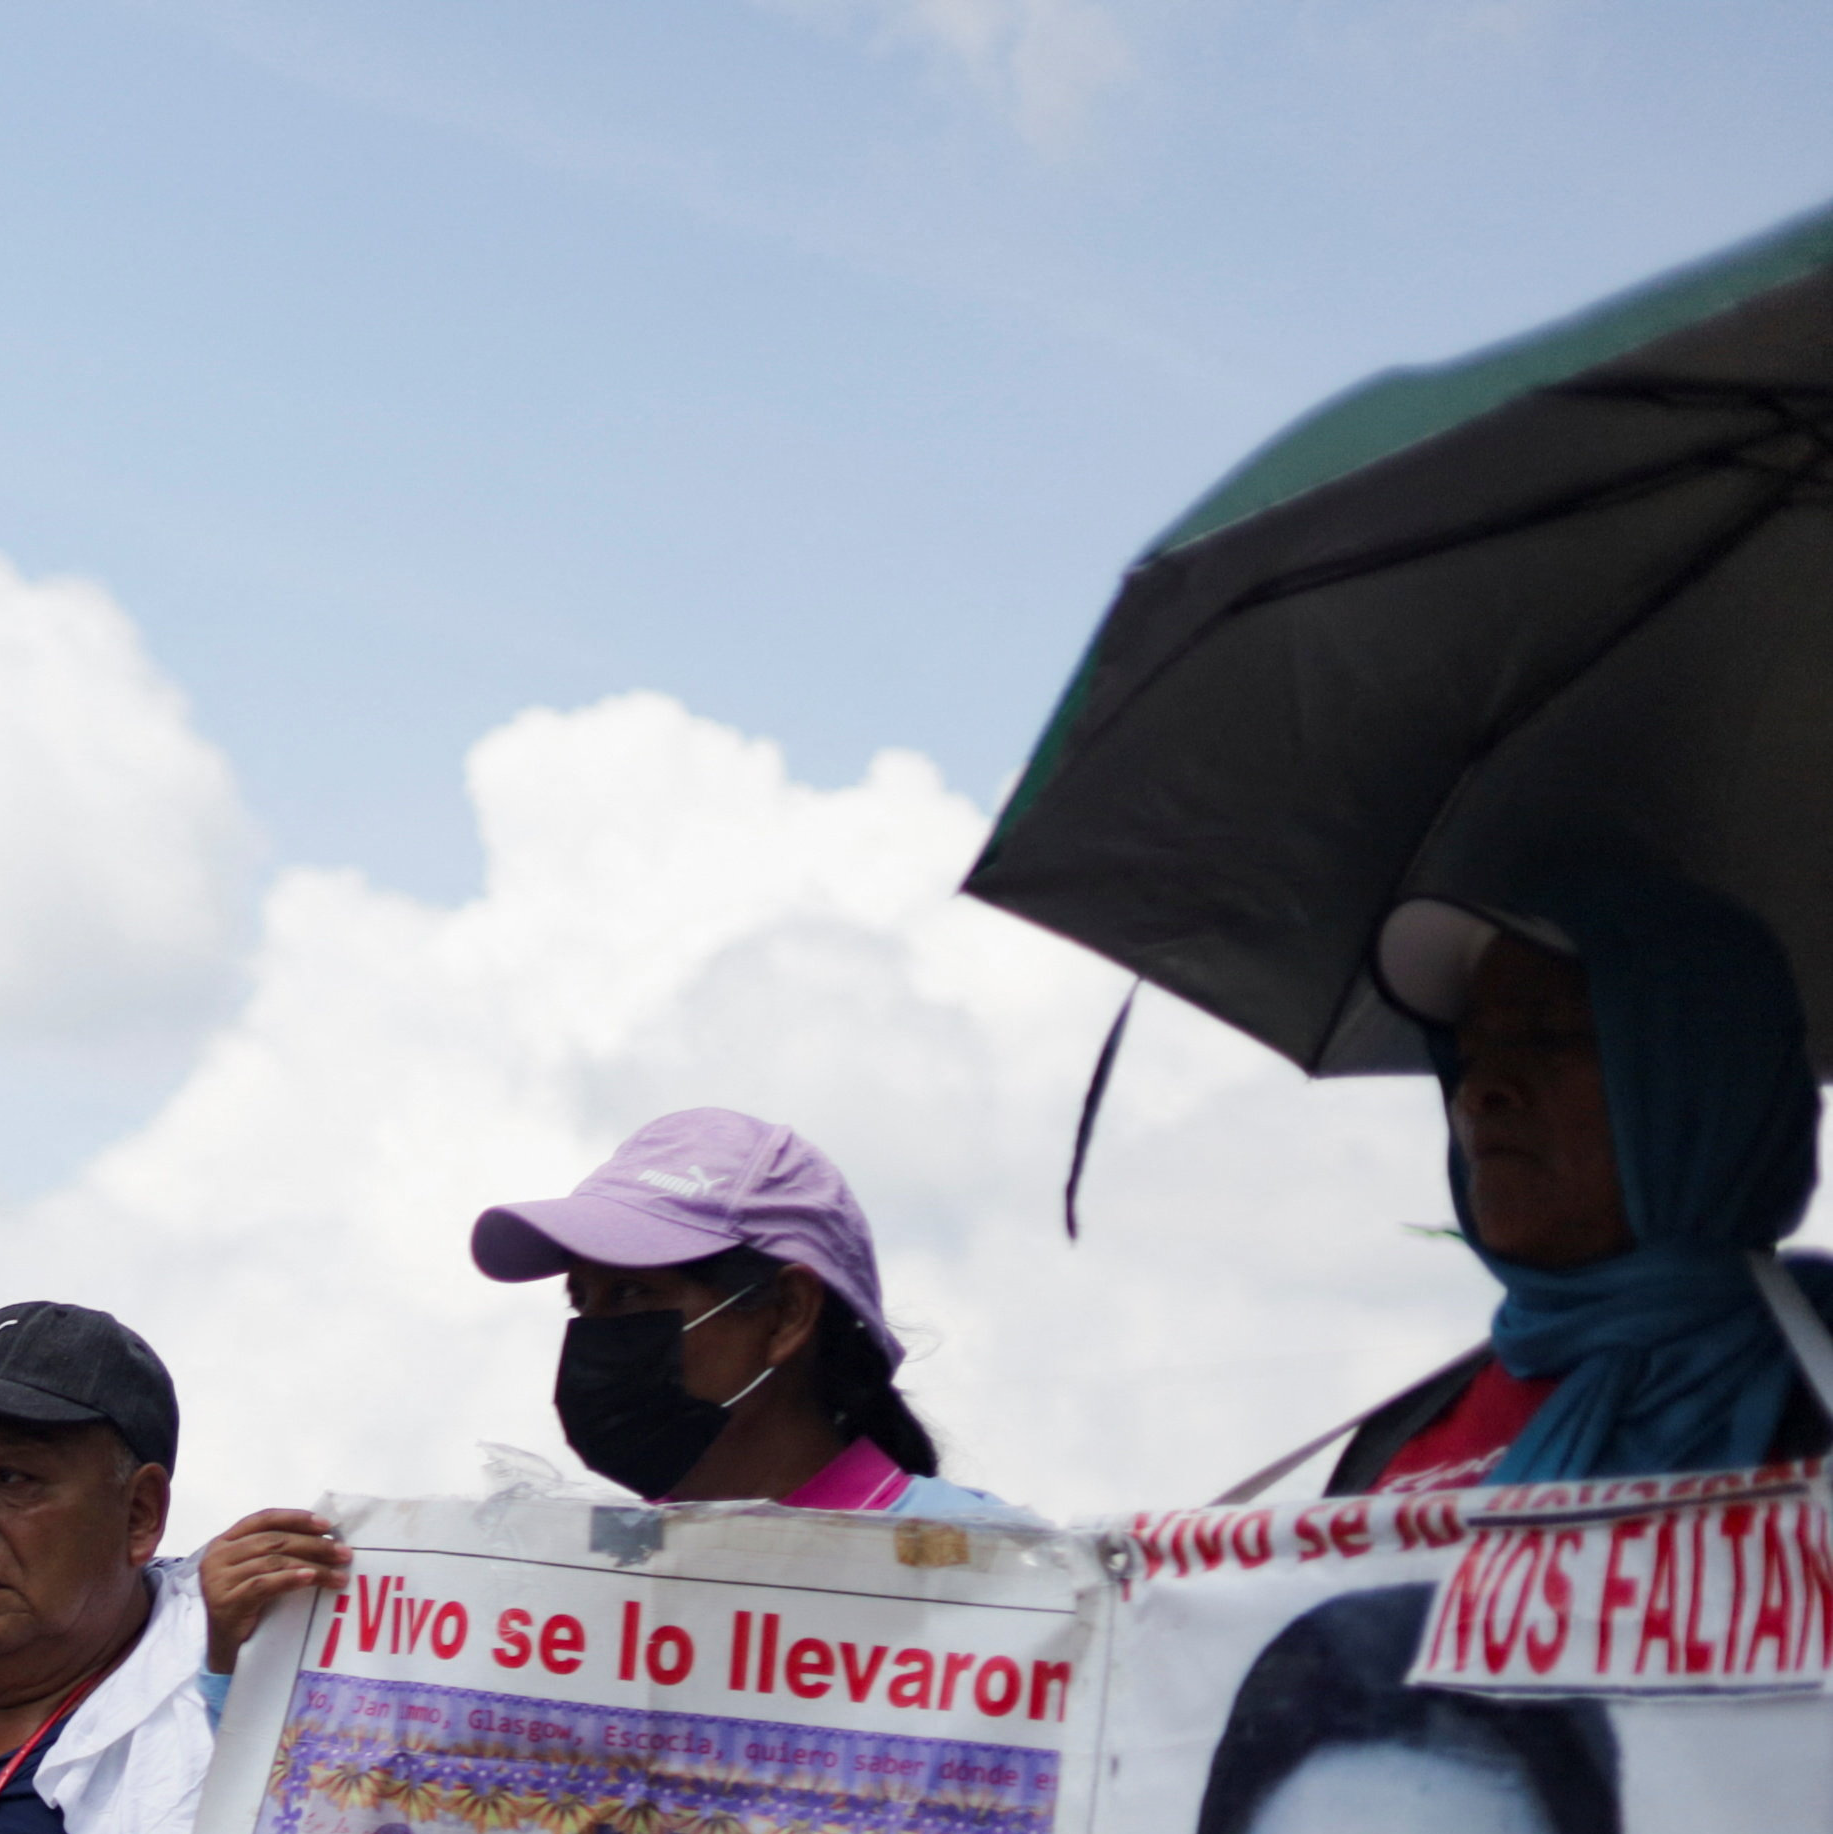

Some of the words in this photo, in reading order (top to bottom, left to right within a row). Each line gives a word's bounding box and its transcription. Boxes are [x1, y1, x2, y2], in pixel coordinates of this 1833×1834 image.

[638, 1168, 700, 1198] PUMA
[1296, 1501, 1371, 1563] se
[1428, 1518, 1585, 1677] NOS
[319, 1574, 469, 1668] ¡Vivo
[492, 1609, 586, 1676] se
[618, 1601, 695, 1687] lo
[729, 1609, 1073, 1723] llevaron
[352, 1696, 390, 1717] Jan
[467, 1708, 585, 1747] Glasgow,
[603, 1725, 724, 1762] Escocia,
[744, 1741, 839, 1770] quiero
[853, 1753, 926, 1778] saber
[941, 1757, 1020, 1789] dónde
